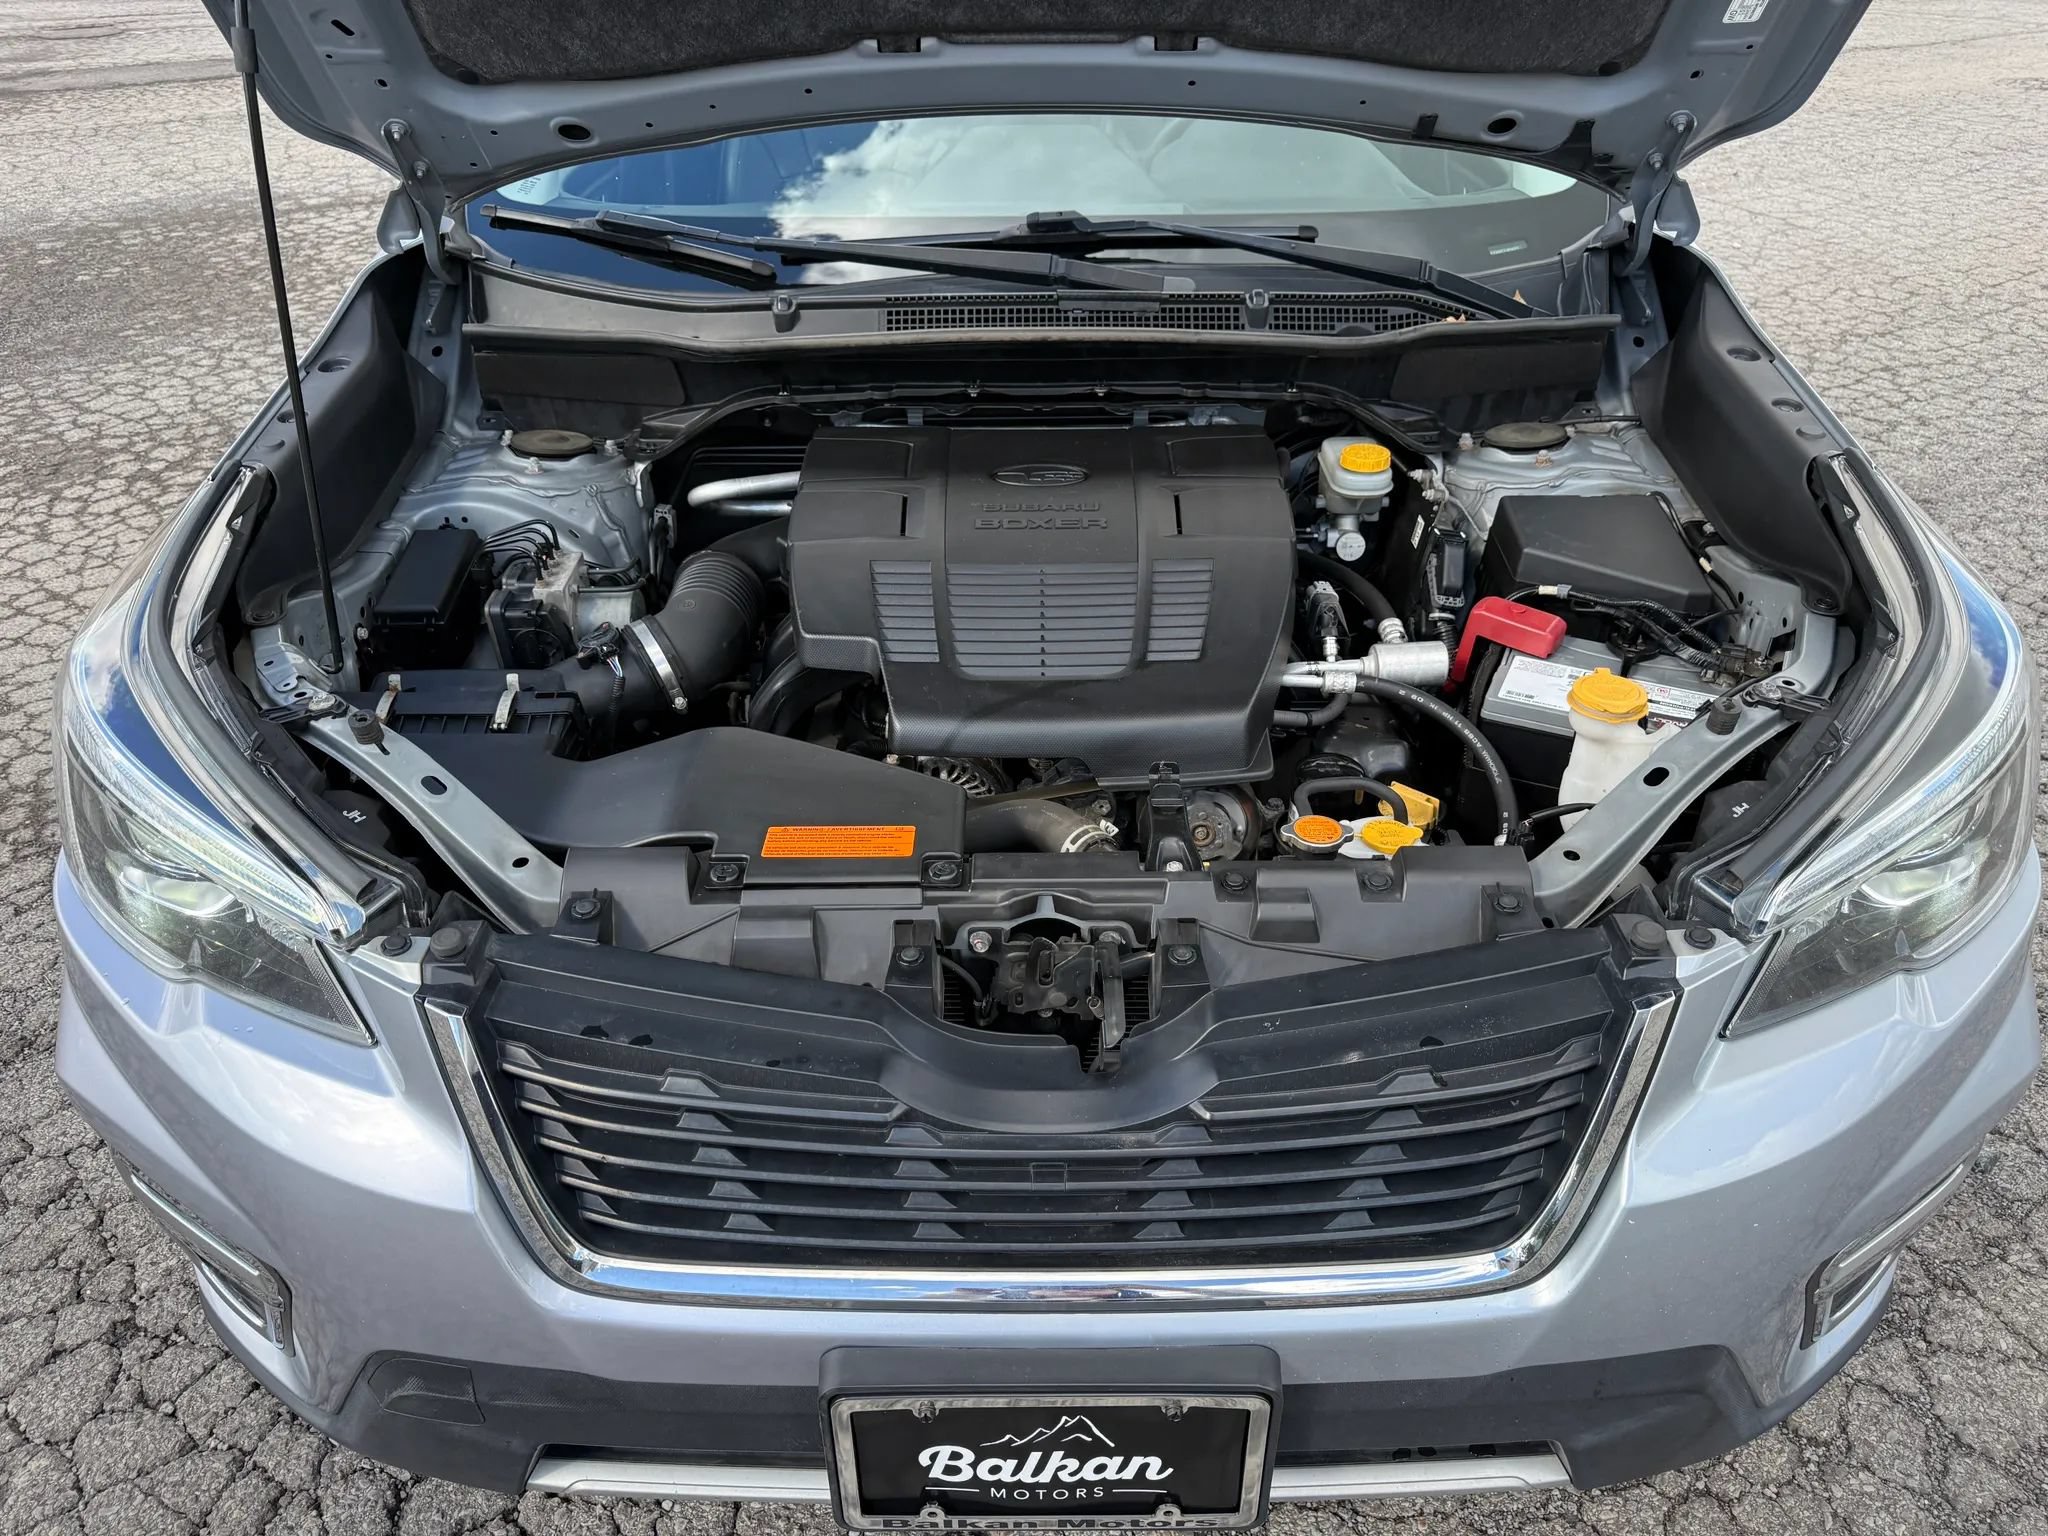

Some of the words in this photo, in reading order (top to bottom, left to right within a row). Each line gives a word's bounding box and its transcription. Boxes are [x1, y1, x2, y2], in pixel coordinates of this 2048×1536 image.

[982, 503, 1101, 513] SUBARU
[974, 517, 1108, 530] BOXER
[342, 809, 367, 823] JH
[1731, 802, 1750, 818] JH
[918, 1444, 1174, 1484] Balkan
[990, 1486, 1105, 1500] MOTORS
[881, 1518, 1038, 1530] Balkan
[1057, 1517, 1219, 1529] Motors
